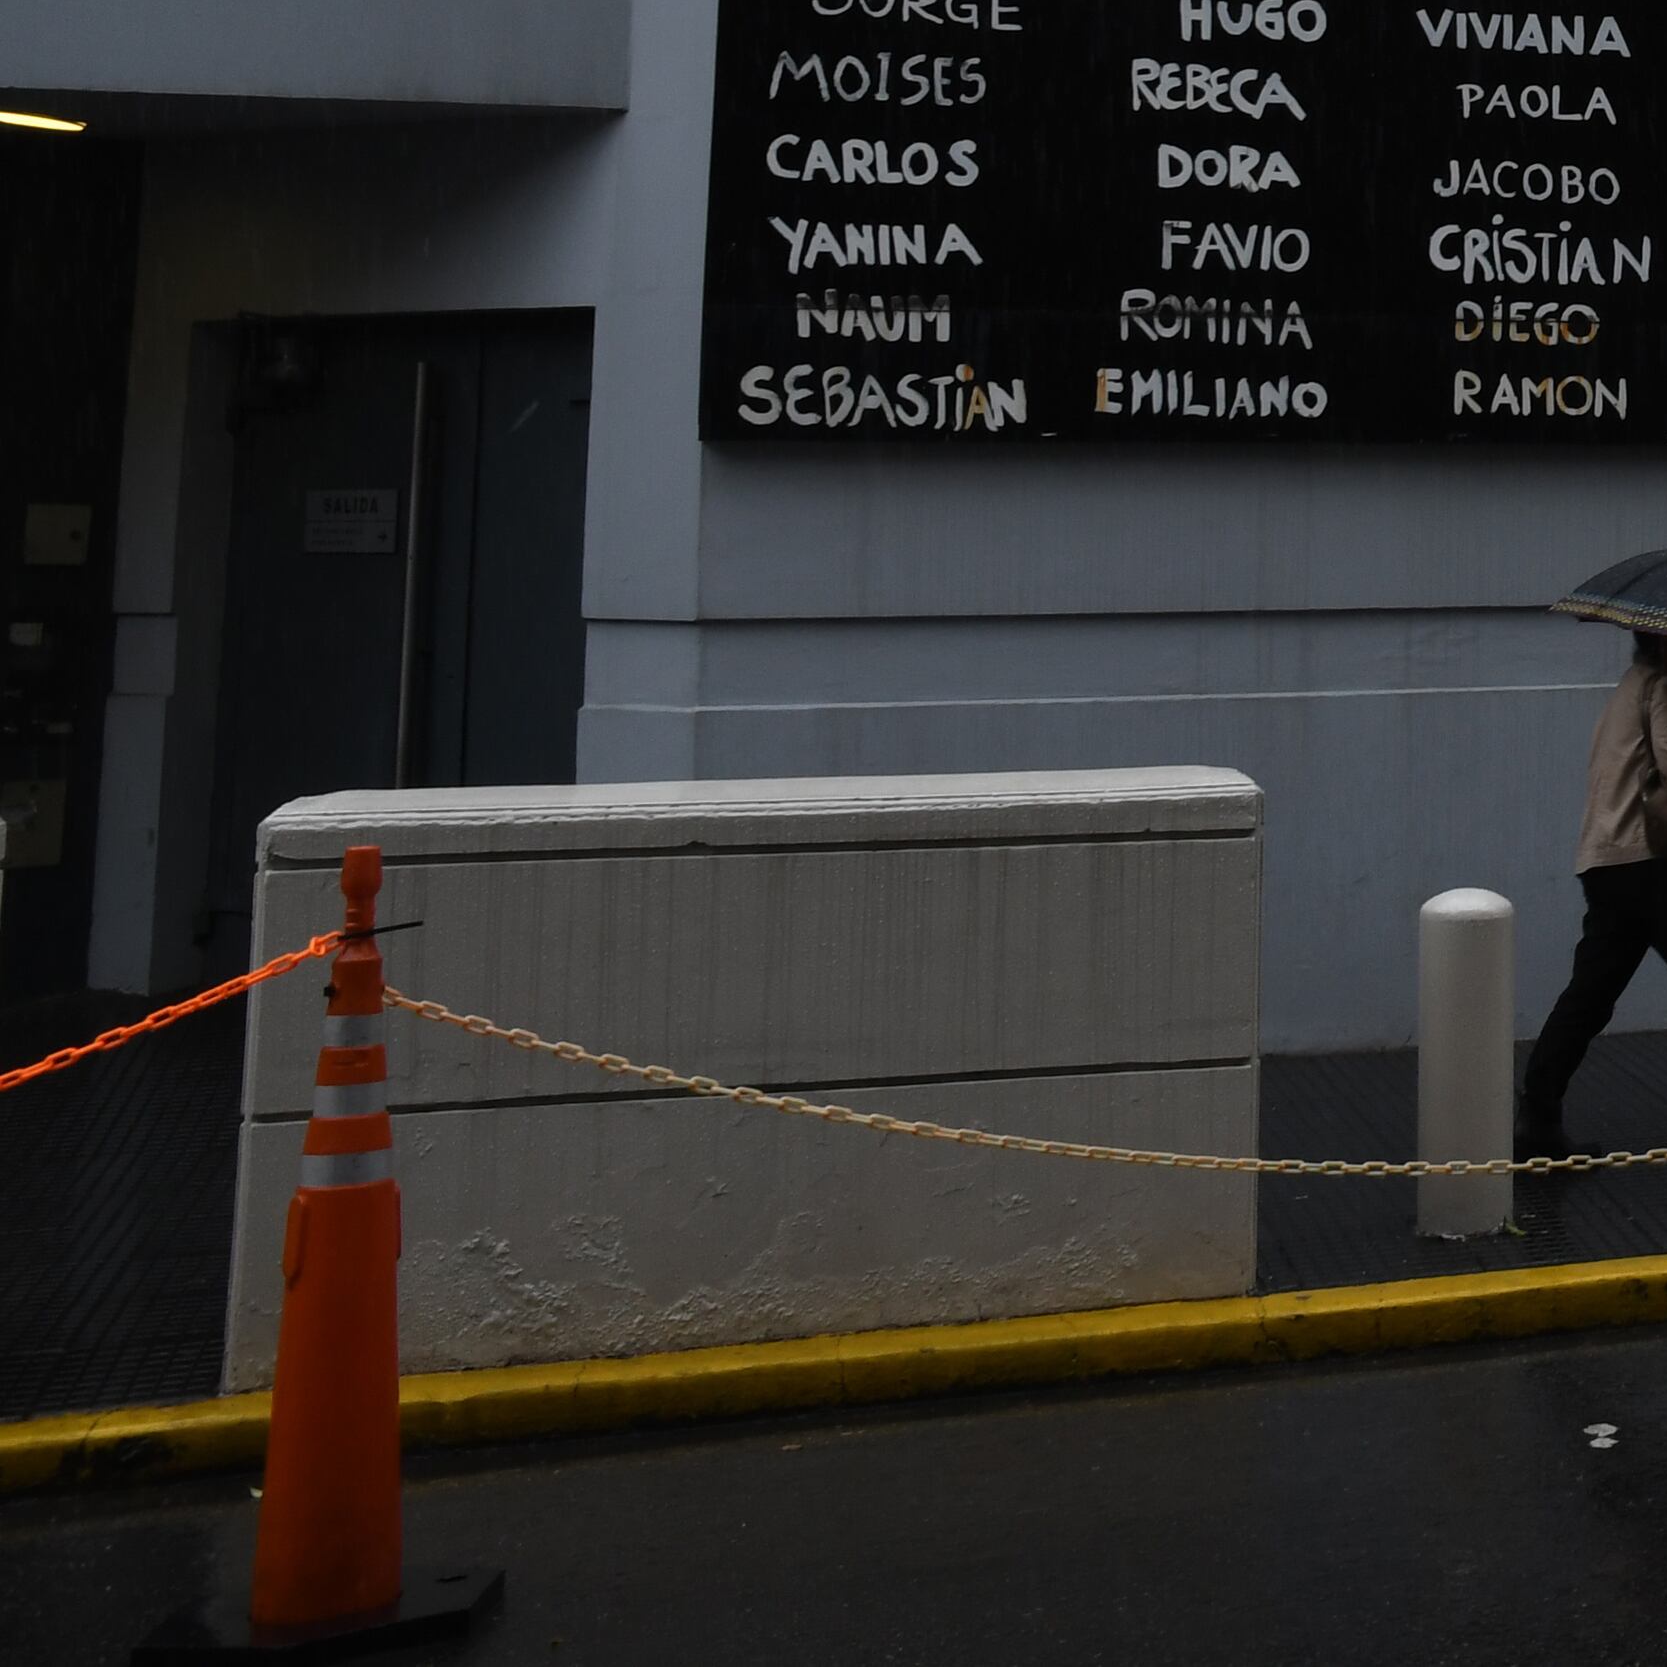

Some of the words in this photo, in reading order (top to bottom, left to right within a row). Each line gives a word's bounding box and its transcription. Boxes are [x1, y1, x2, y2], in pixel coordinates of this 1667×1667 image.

[1416, 8, 1632, 57] VIVIANA
[769, 52, 986, 106] MOISES
[1131, 58, 1307, 122] REBECA
[1457, 84, 1617, 125] PAOLA
[766, 134, 980, 186] CARLOS
[1157, 144, 1300, 193] DORA
[1432, 159, 1621, 205] JACOBO
[767, 216, 983, 275] YANINA
[1161, 220, 1310, 272] FAVIO
[1428, 213, 1651, 285] CRISTIAN
[796, 288, 952, 342] NAUM
[1119, 288, 1312, 350] ROMINA
[1455, 296, 1600, 345] DIEGO
[738, 363, 1027, 431] SEBASTIAN
[1095, 367, 1328, 420] EMILIANO
[1453, 369, 1628, 420] RAMON
[323, 497, 378, 513] SALIDA
